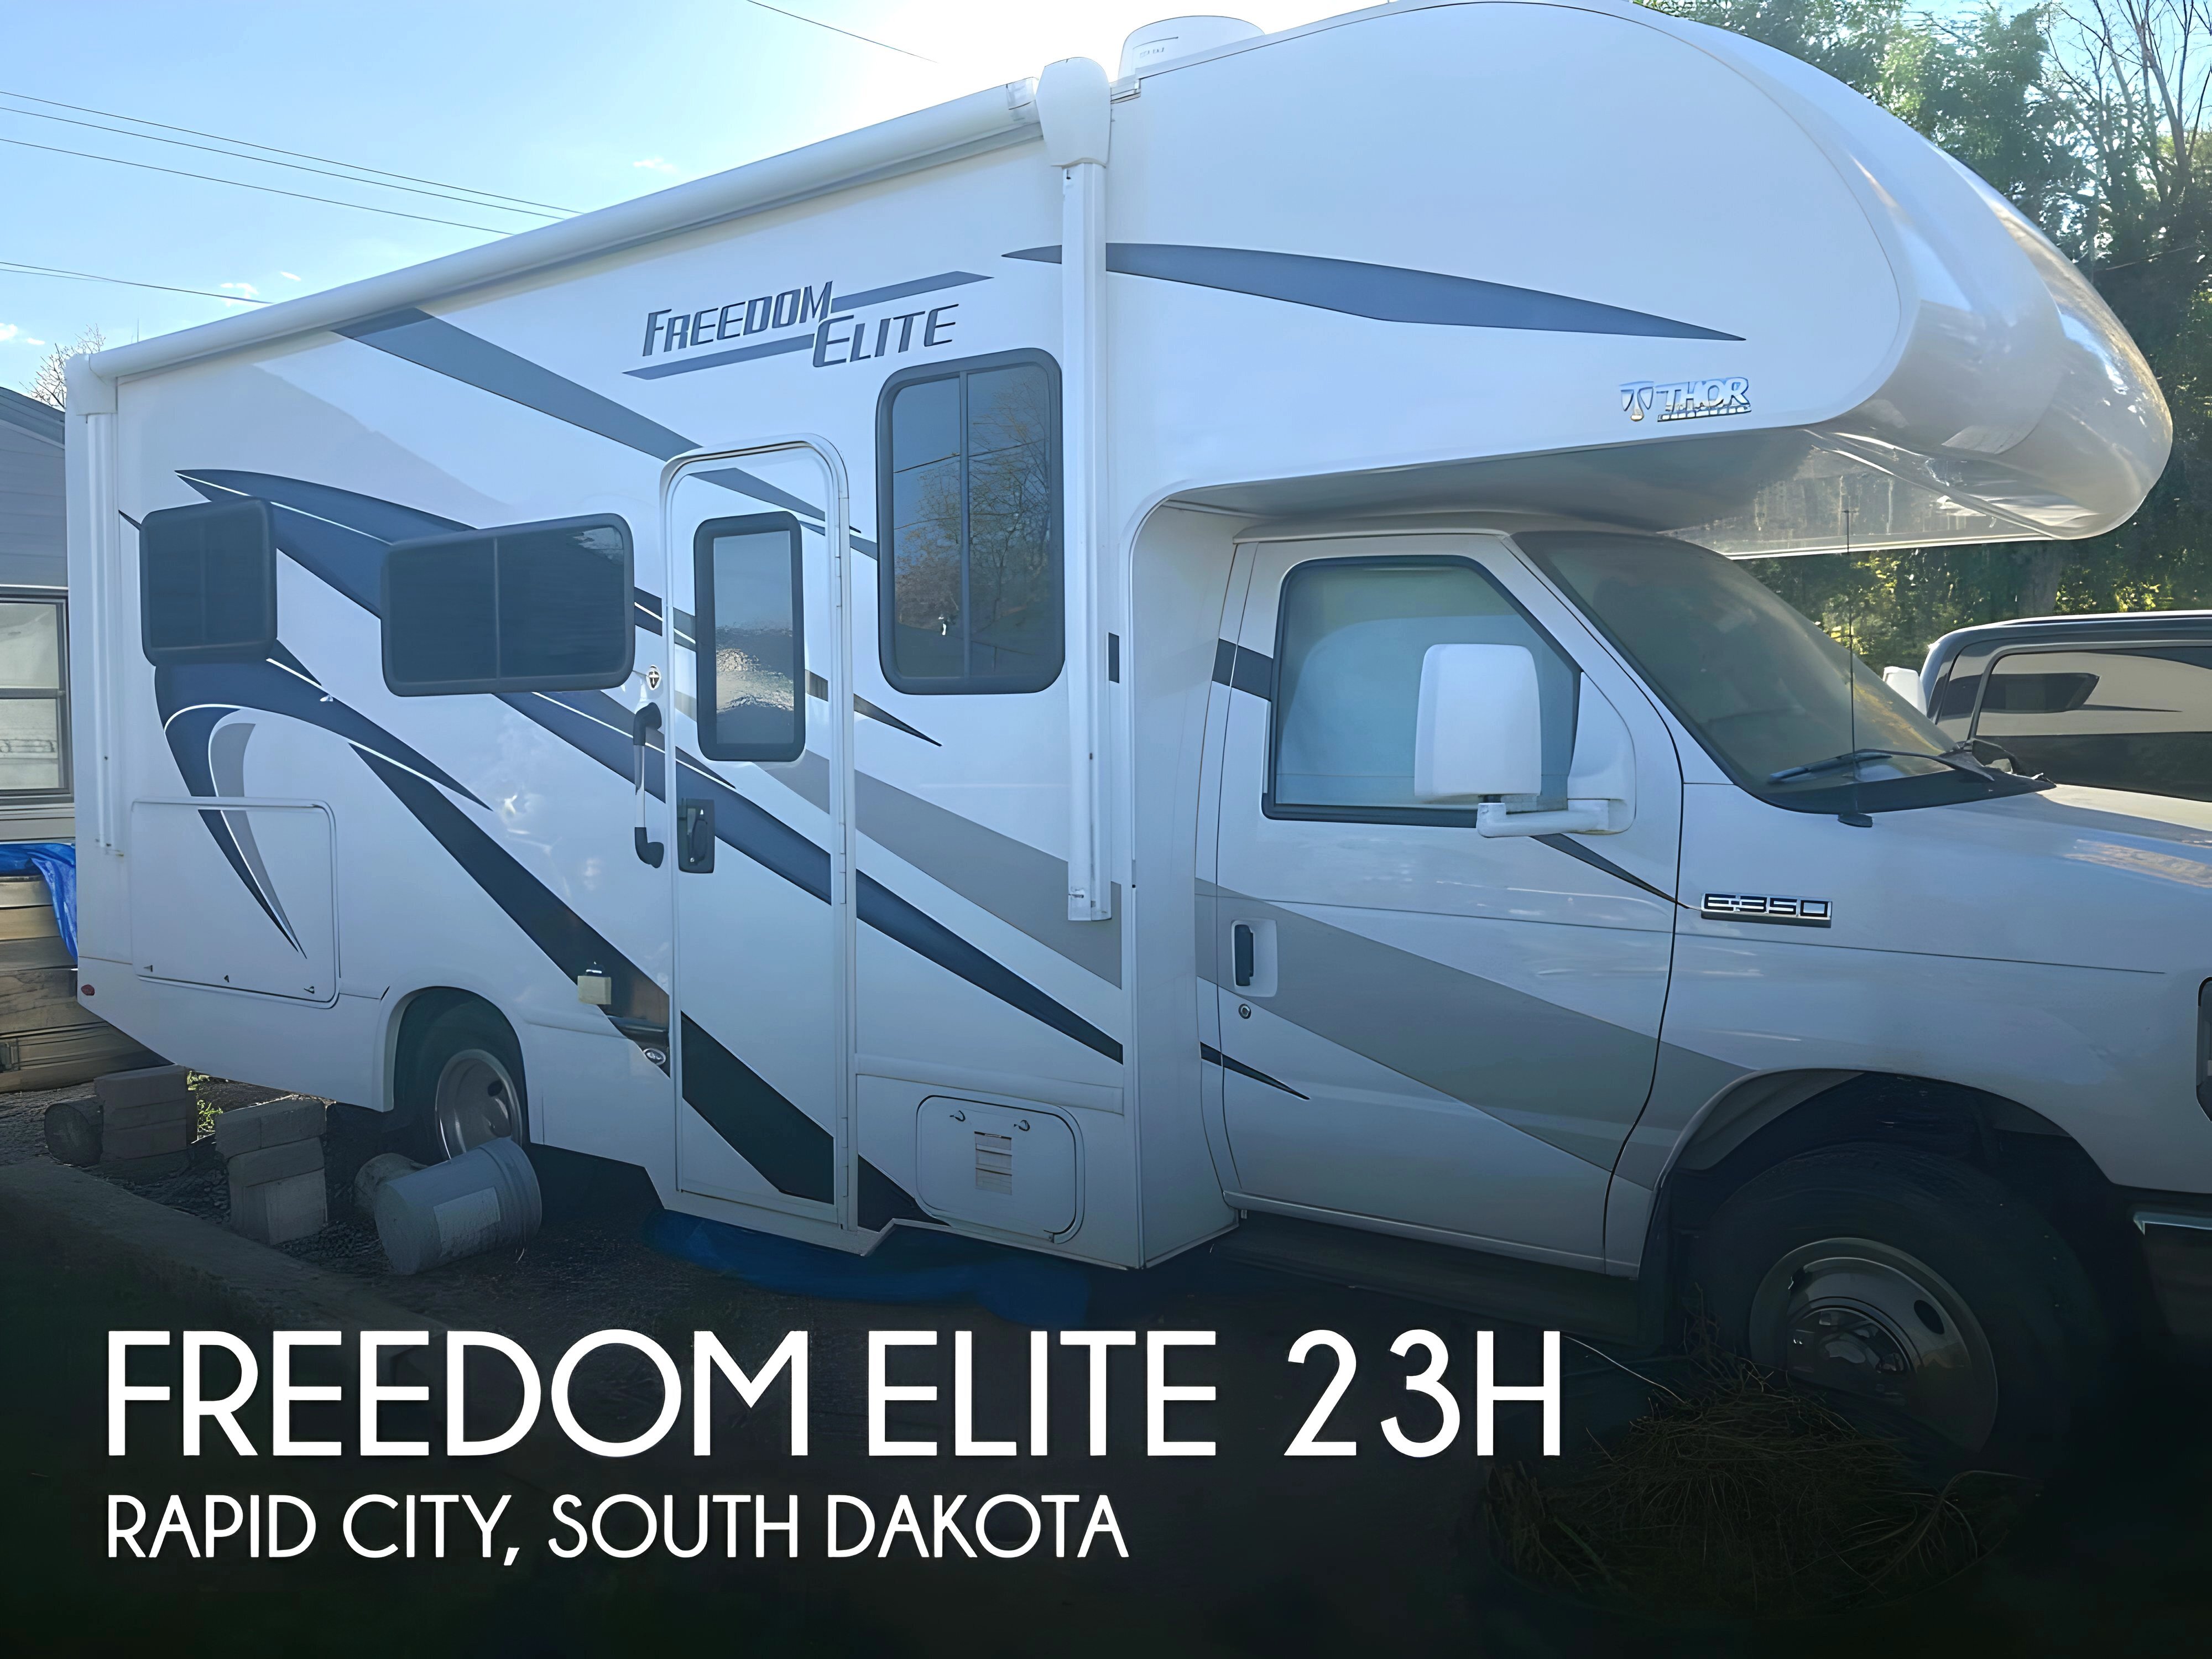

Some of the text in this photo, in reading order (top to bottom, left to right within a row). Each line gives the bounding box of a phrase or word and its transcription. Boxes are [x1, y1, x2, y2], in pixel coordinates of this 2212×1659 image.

[642, 280, 833, 357] FREEDOM
[812, 304, 959, 368] ELITE
[1656, 377, 1751, 411] THOR
